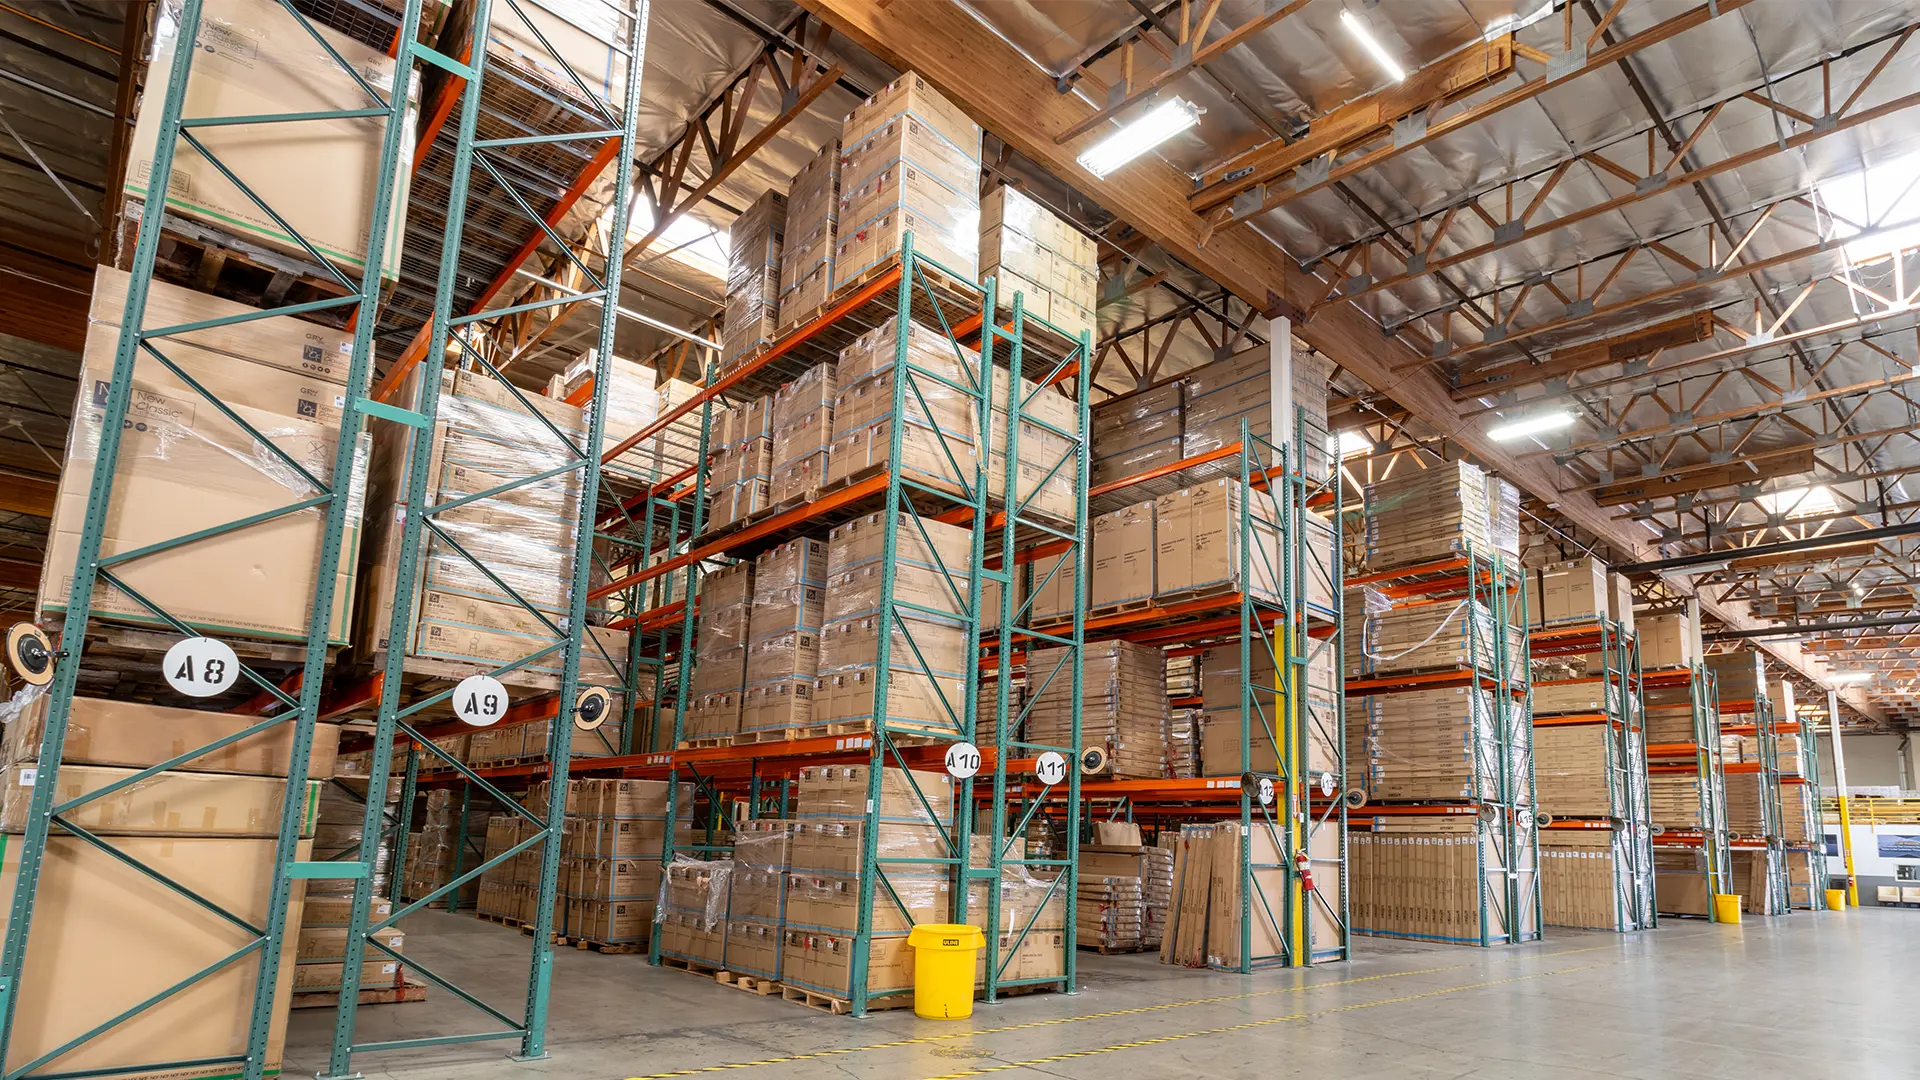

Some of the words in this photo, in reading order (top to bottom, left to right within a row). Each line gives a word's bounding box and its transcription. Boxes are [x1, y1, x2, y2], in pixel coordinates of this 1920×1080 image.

[206, 22, 232, 36] New
[305, 333, 324, 341] GRY
[136, 391, 166, 405] New
[300, 387, 318, 397] GRY
[135, 402, 180, 418] Classic
[463, 692, 498, 715] A9
[946, 752, 980, 770] A10
[1037, 761, 1065, 776] A11
